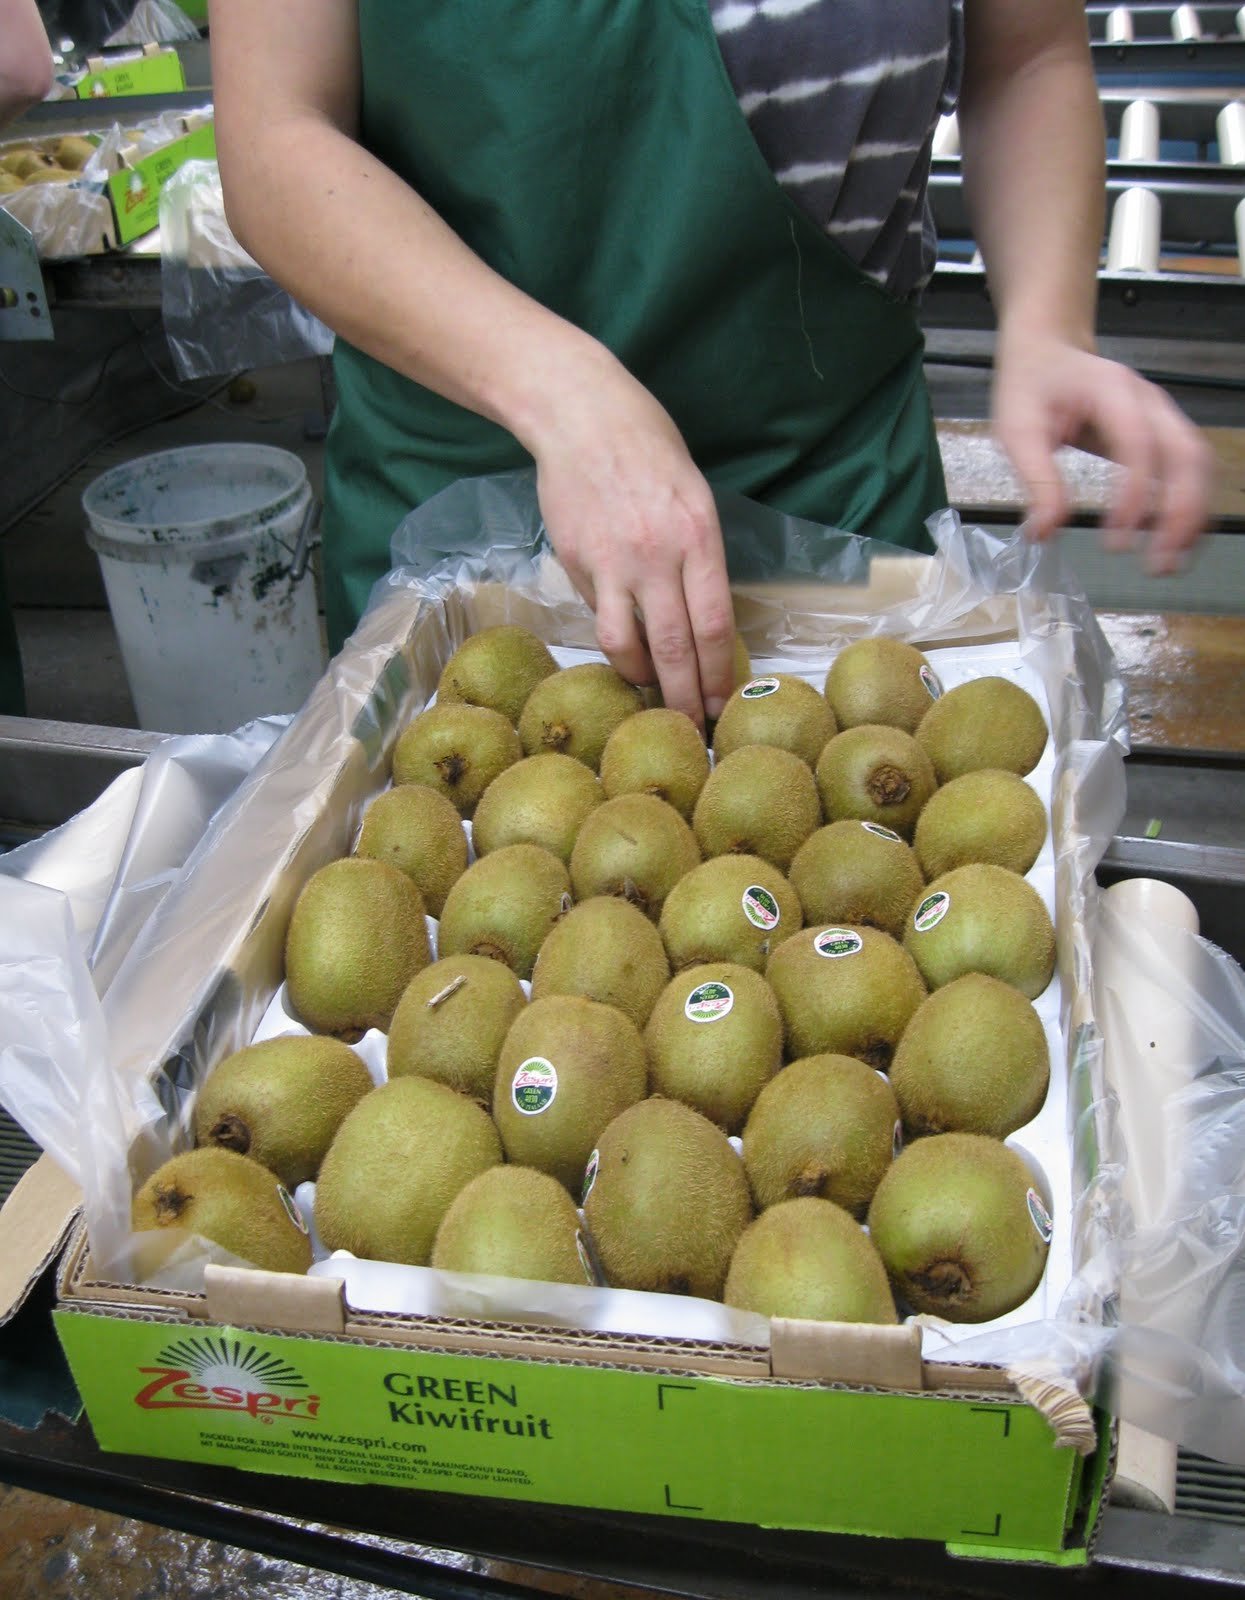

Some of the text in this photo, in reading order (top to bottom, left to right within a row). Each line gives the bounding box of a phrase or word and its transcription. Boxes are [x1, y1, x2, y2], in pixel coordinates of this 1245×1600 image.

[134, 1367, 321, 1421] Zespri
[383, 1372, 518, 1407] GREEN
[388, 1400, 554, 1440] Kiwifruit
[199, 1431, 234, 1442] PACKED
[260, 1440, 289, 1449] ZESPRI
[292, 1443, 366, 1458] INTERNATIONAL
[291, 1429, 427, 1454] www.zespri.com
[314, 1454, 336, 1463] NEW
[455, 1471, 490, 1481] GROUP
[315, 1462, 330, 1470] ALL
[333, 1464, 368, 1475] RIGHTS
